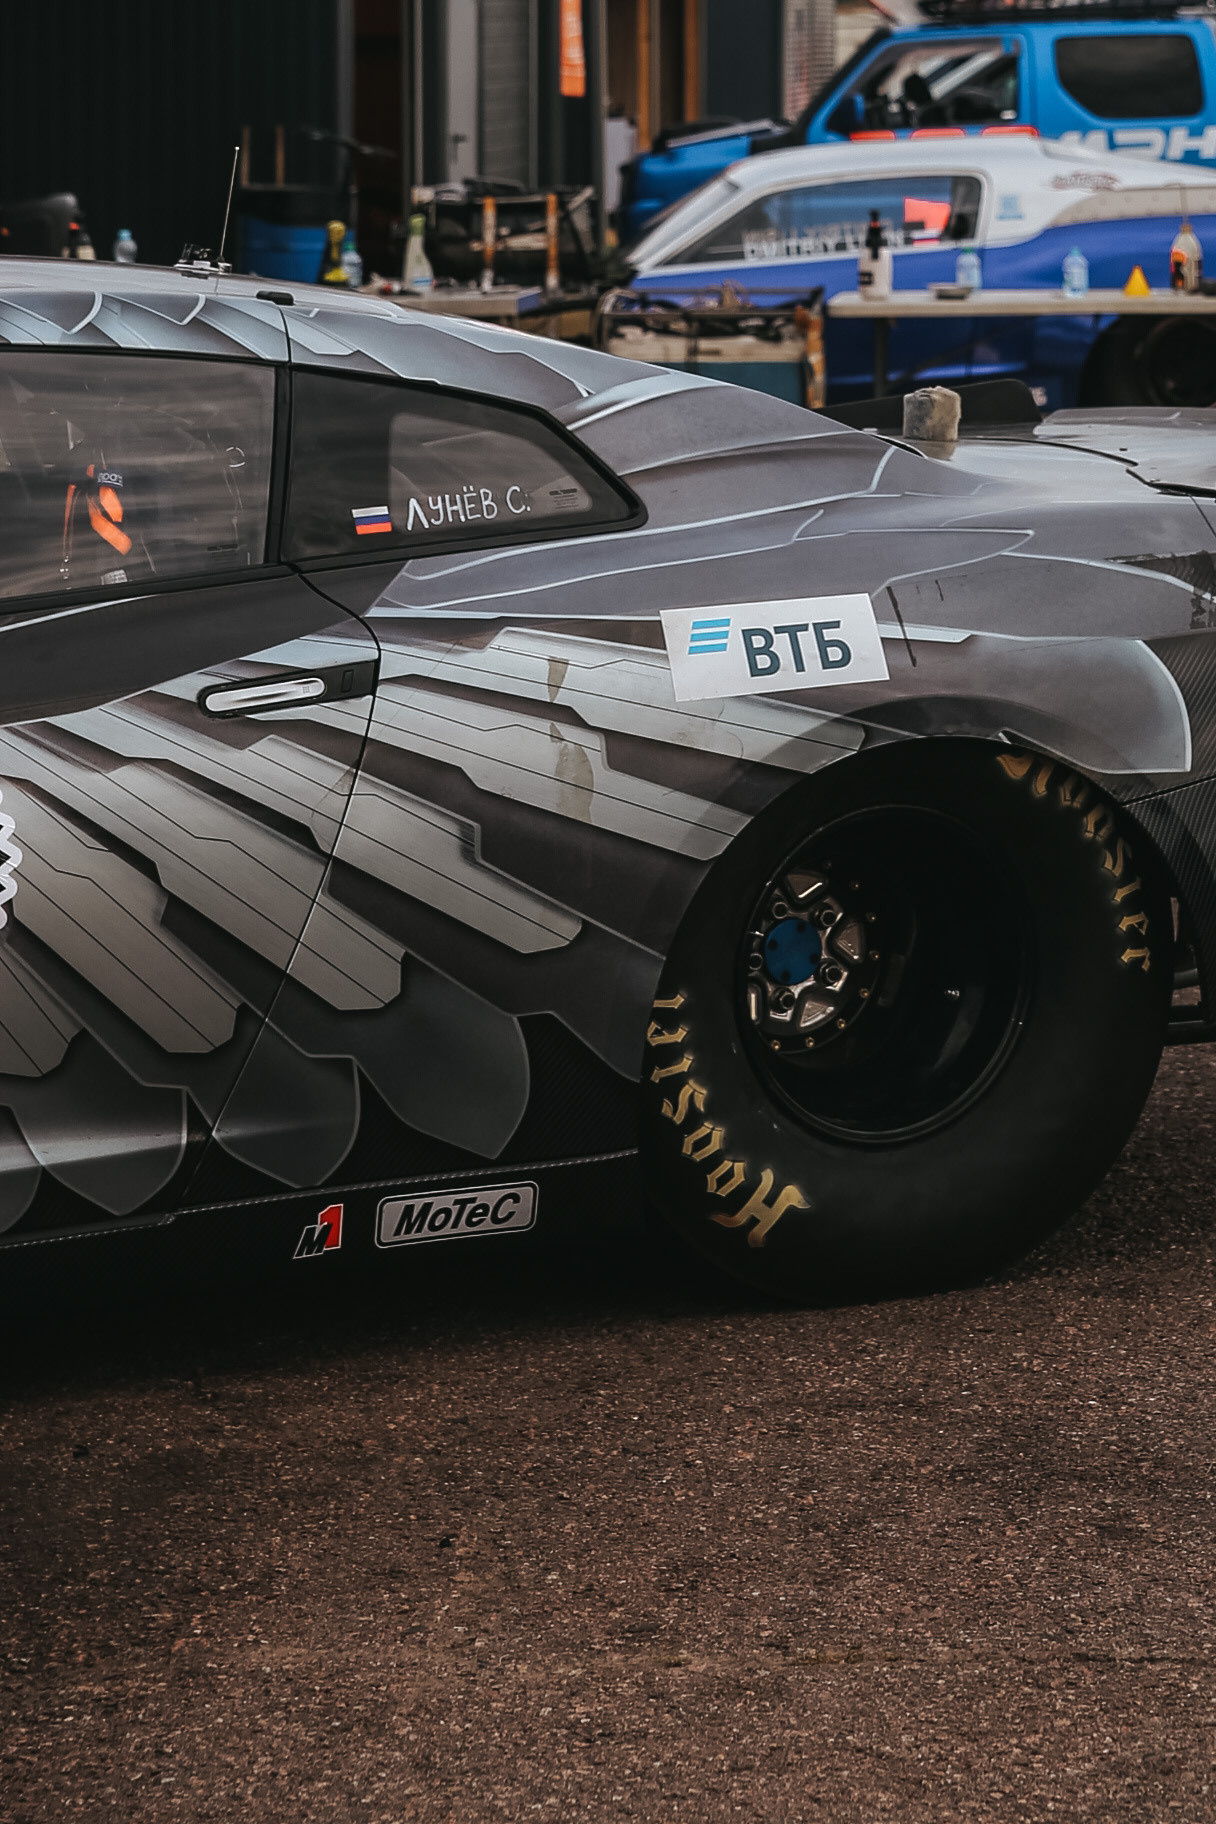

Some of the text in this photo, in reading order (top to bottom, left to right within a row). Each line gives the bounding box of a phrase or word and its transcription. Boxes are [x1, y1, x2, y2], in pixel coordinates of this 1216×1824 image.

[406, 485, 499, 532] ЛУНЁВ
[740, 619, 853, 678] ВТБ
[292, 1191, 522, 1259] M1 MoTeC
